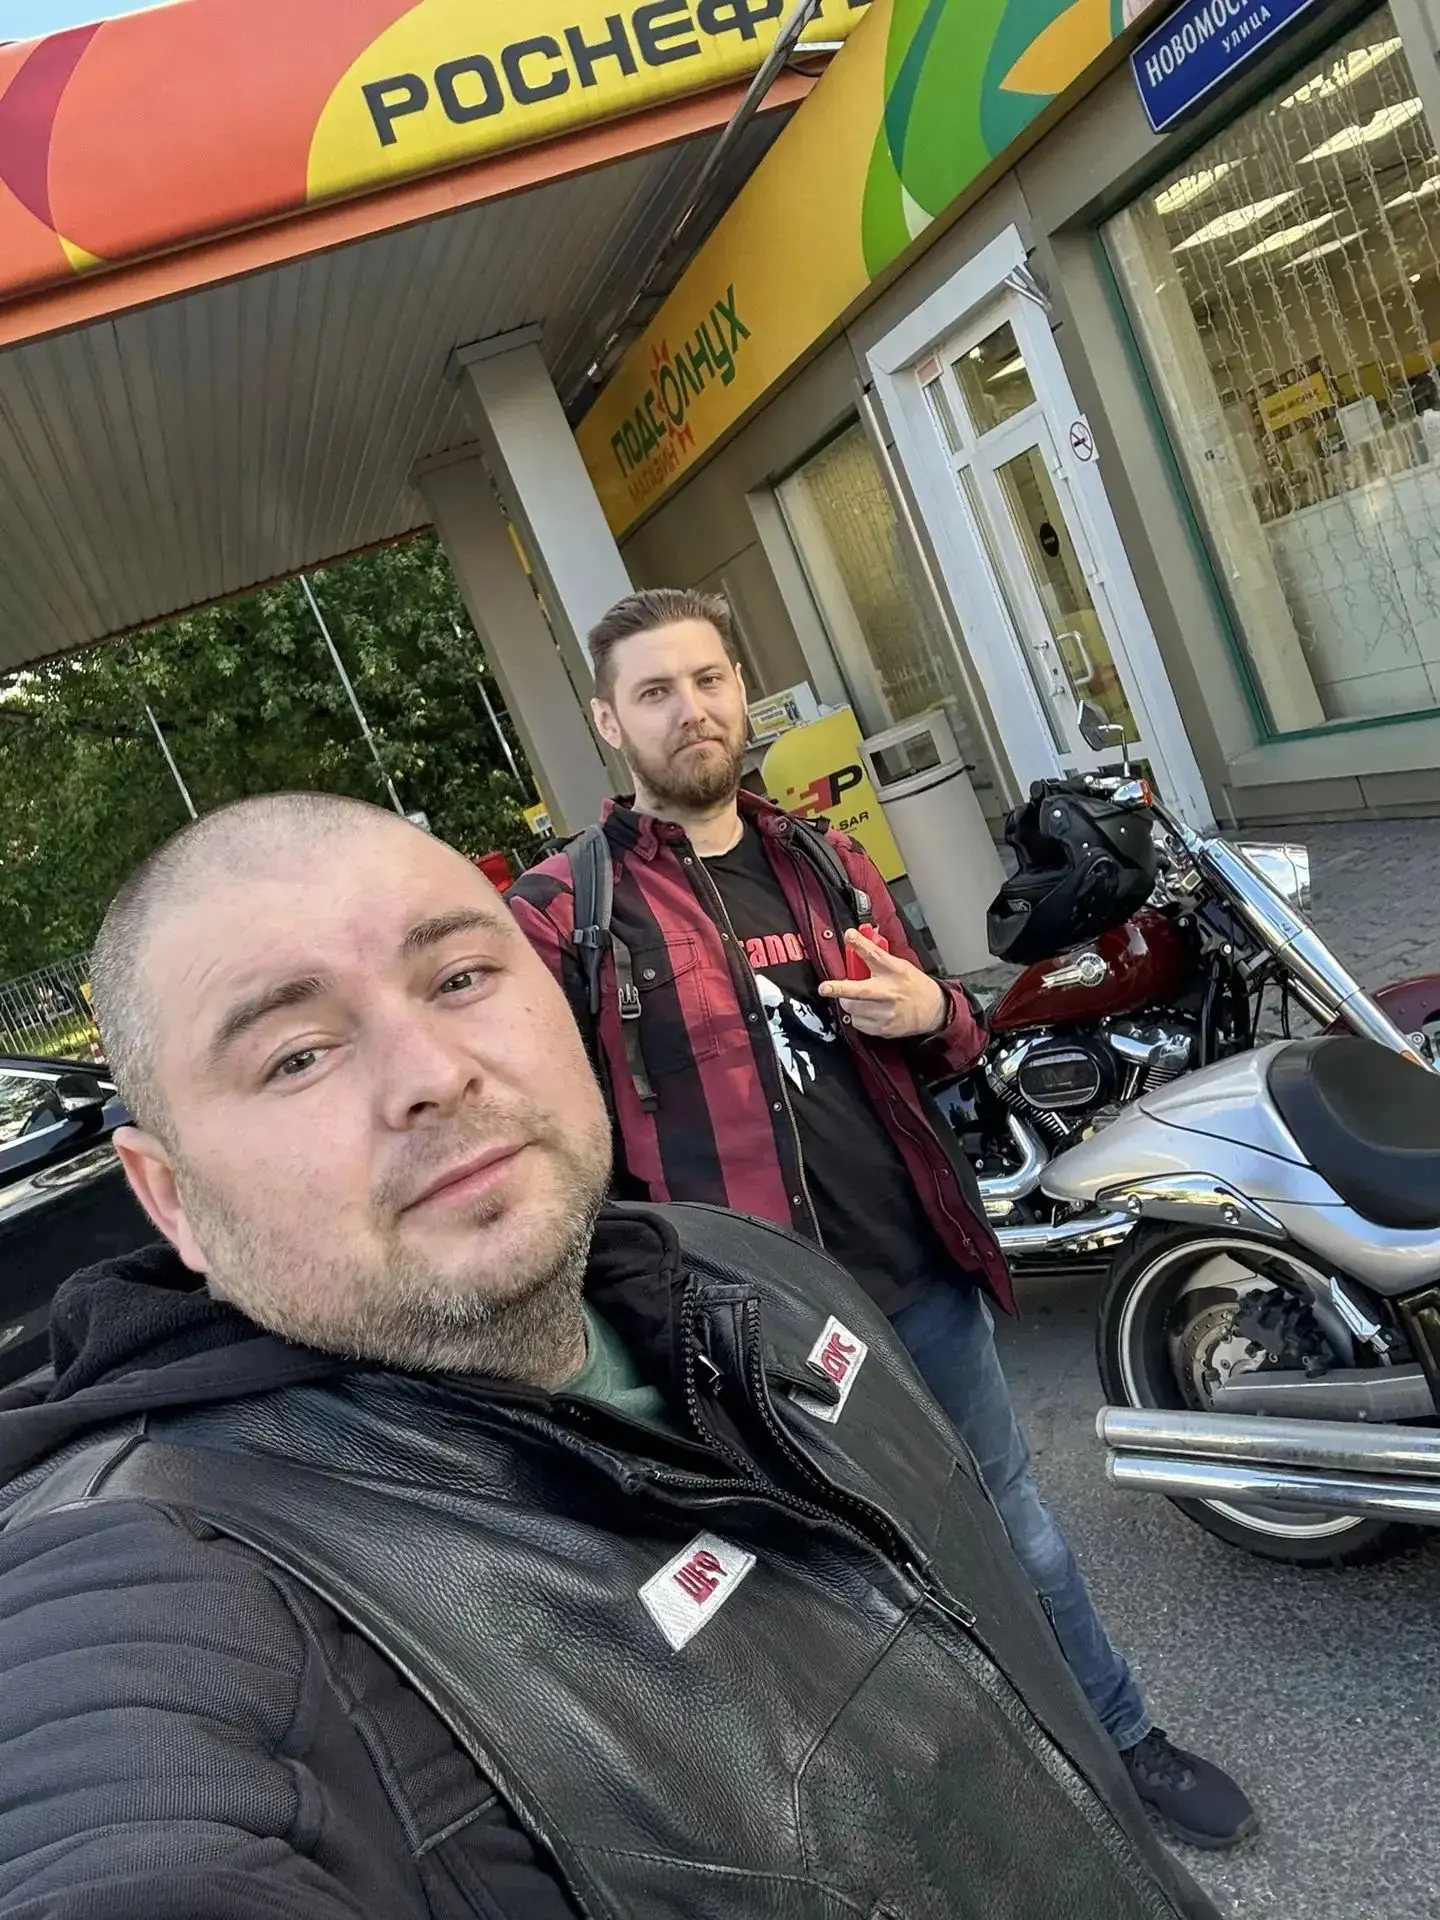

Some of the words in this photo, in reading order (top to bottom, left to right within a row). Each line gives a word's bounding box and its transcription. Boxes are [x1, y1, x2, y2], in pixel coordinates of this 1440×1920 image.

[1144, 0, 1249, 87] НОВОМОС
[1221, 5, 1272, 54] УЛИЦА
[362, 0, 875, 148] РОСНЕФ
[610, 283, 752, 478] ПОДСОЛНУХ
[834, 811, 869, 831] SAR
[739, 932, 807, 968] ano
[819, 1332, 856, 1383] ДУС
